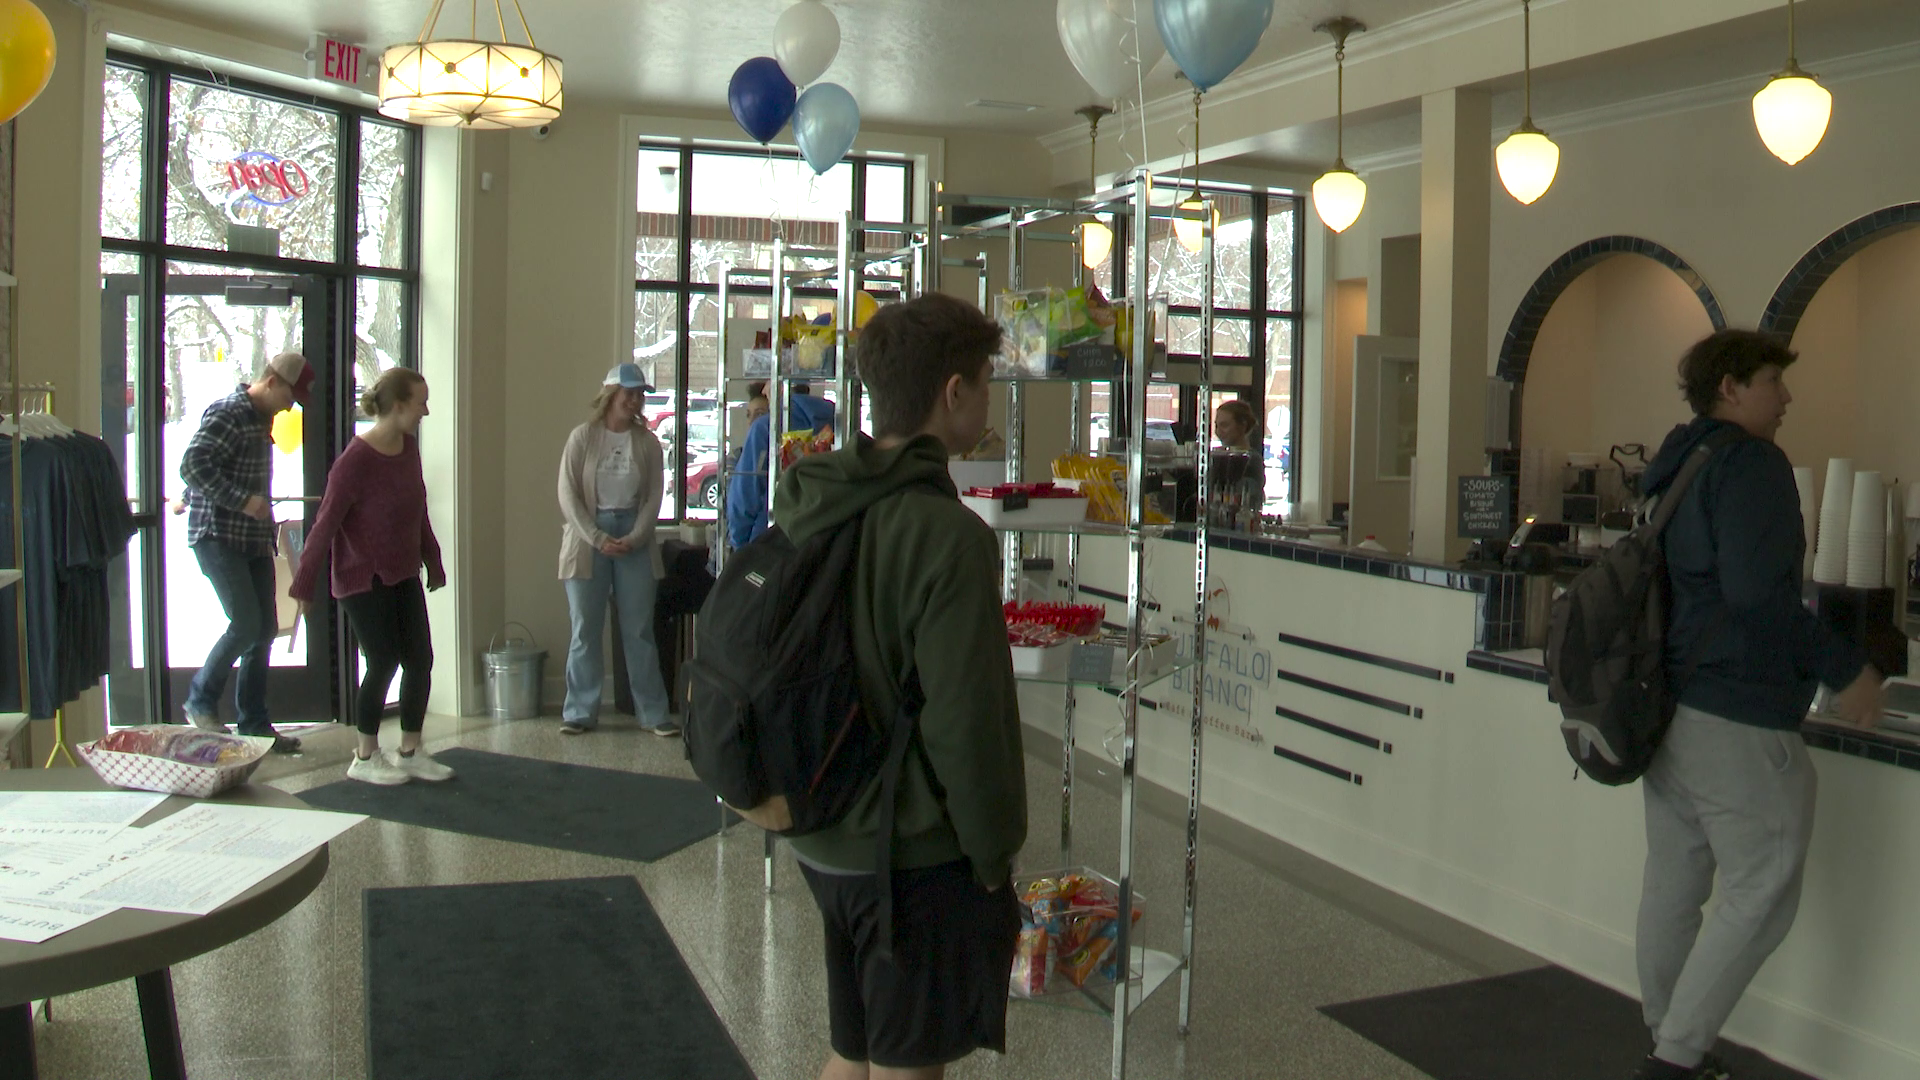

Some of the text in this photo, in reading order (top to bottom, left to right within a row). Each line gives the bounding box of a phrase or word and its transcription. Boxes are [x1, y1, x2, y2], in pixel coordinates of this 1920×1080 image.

[325, 39, 361, 84] EXIT
[1463, 491, 1496, 499] TOMATO
[1463, 512, 1502, 521] SOUTHWEST
[1468, 521, 1500, 529] CHICKEN
[1172, 669, 1247, 712] BLANC
[1203, 716, 1231, 732] offee
[37, 862, 111, 895] BUFFALO
